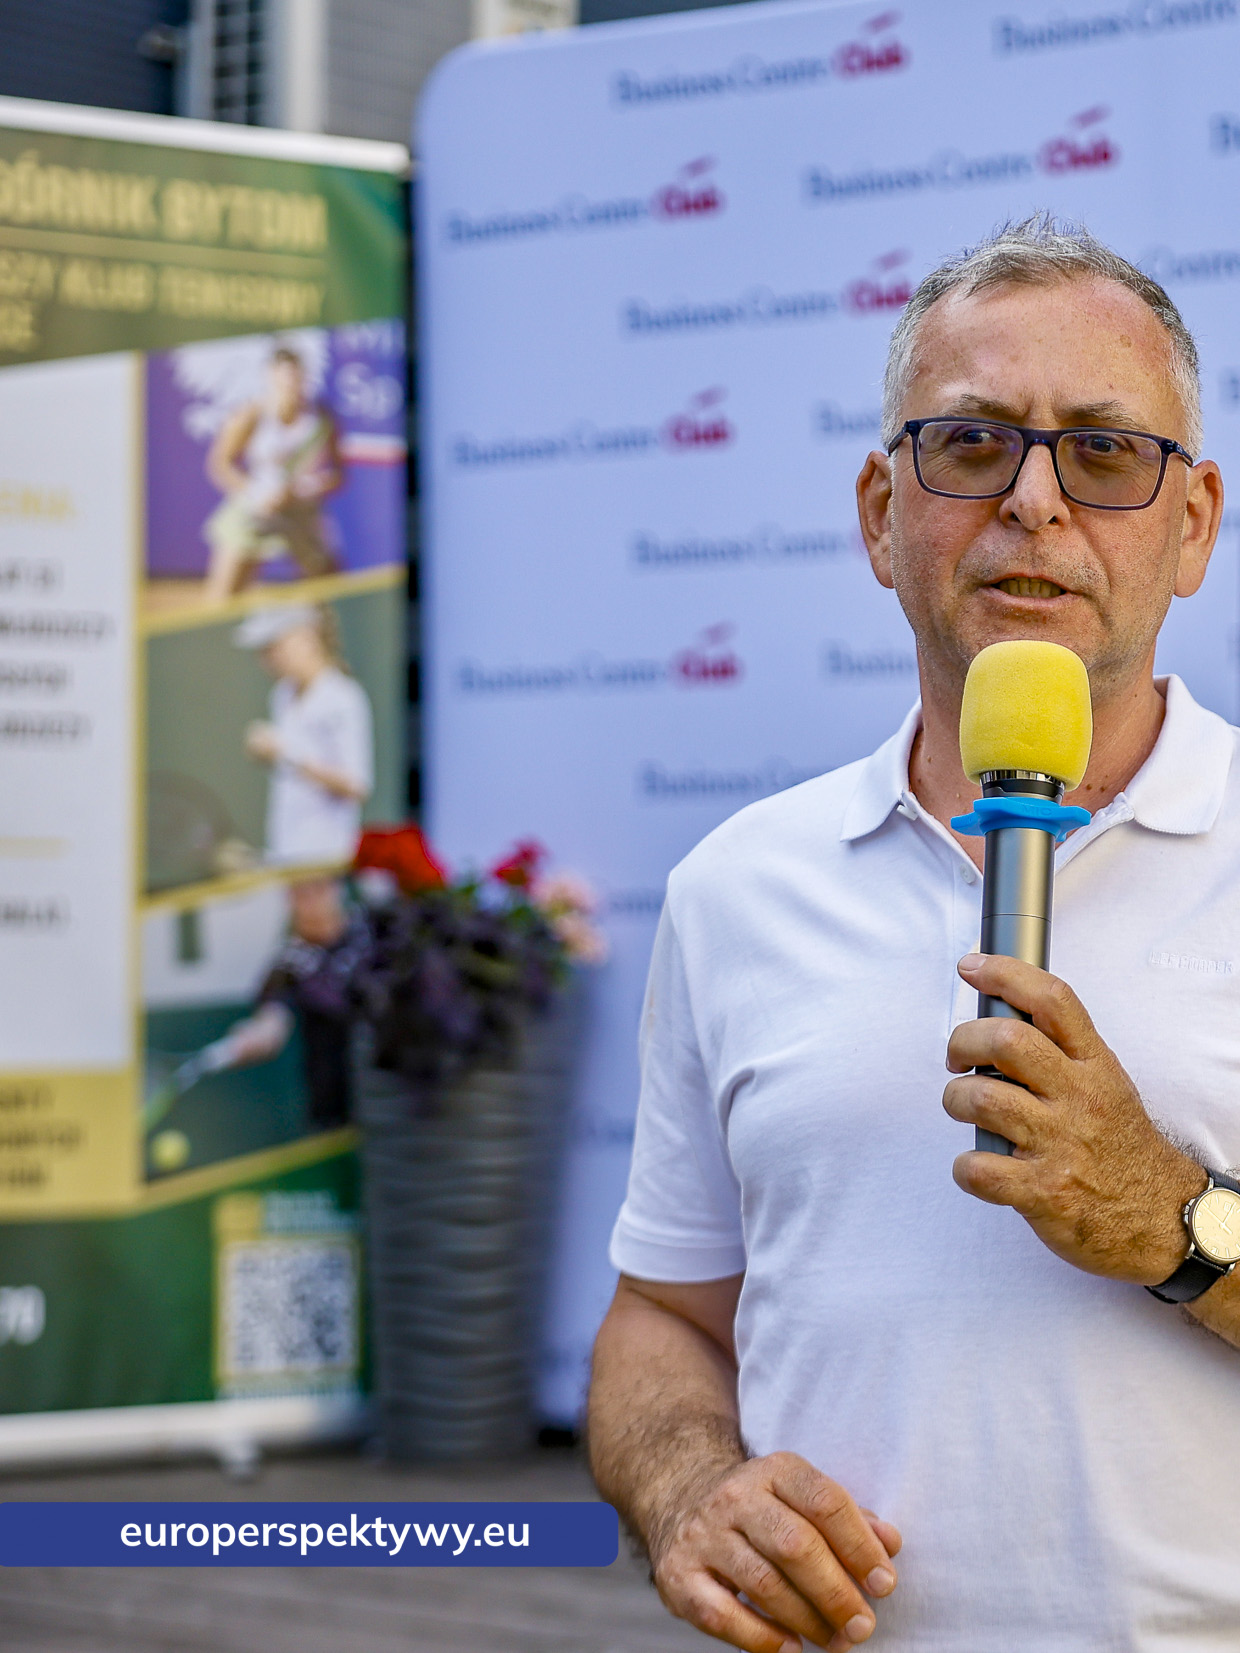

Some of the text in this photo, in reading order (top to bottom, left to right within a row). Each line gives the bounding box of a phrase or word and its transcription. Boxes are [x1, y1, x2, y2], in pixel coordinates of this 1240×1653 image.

[992, 12, 1129, 60] Business
[610, 36, 911, 112] Business Centre Club
[800, 129, 1121, 208] Business Centre Club
[442, 209, 557, 252] Business
[653, 180, 725, 224] Club
[621, 298, 742, 341] Business
[449, 432, 566, 475] Business
[663, 410, 735, 454] Club
[628, 533, 750, 574] Business
